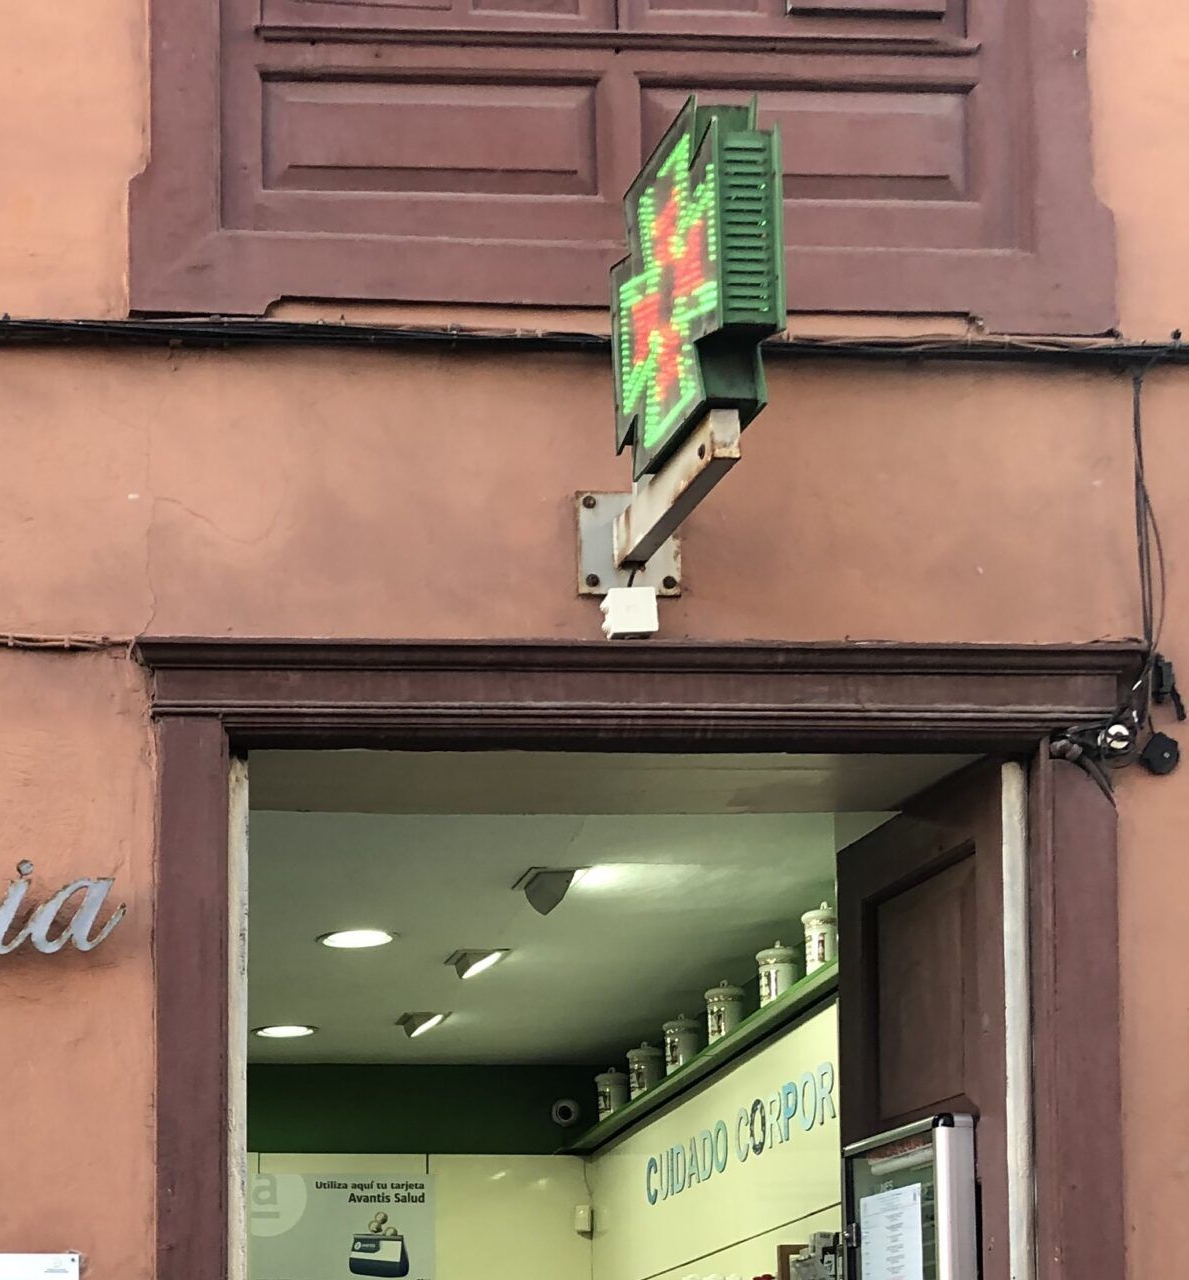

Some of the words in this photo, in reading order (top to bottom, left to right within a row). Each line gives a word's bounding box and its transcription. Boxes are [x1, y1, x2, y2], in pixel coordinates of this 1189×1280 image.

[645, 1120, 728, 1206] CUIDADO
[735, 1061, 837, 1163] CORPOR
[315, 1181, 348, 1190] Utiliza
[351, 1180, 374, 1192] aquí
[376, 1181, 388, 1190] tu
[390, 1181, 425, 1192] tarjeta
[348, 1192, 391, 1204] Avantis
[394, 1192, 425, 1204] Salud
